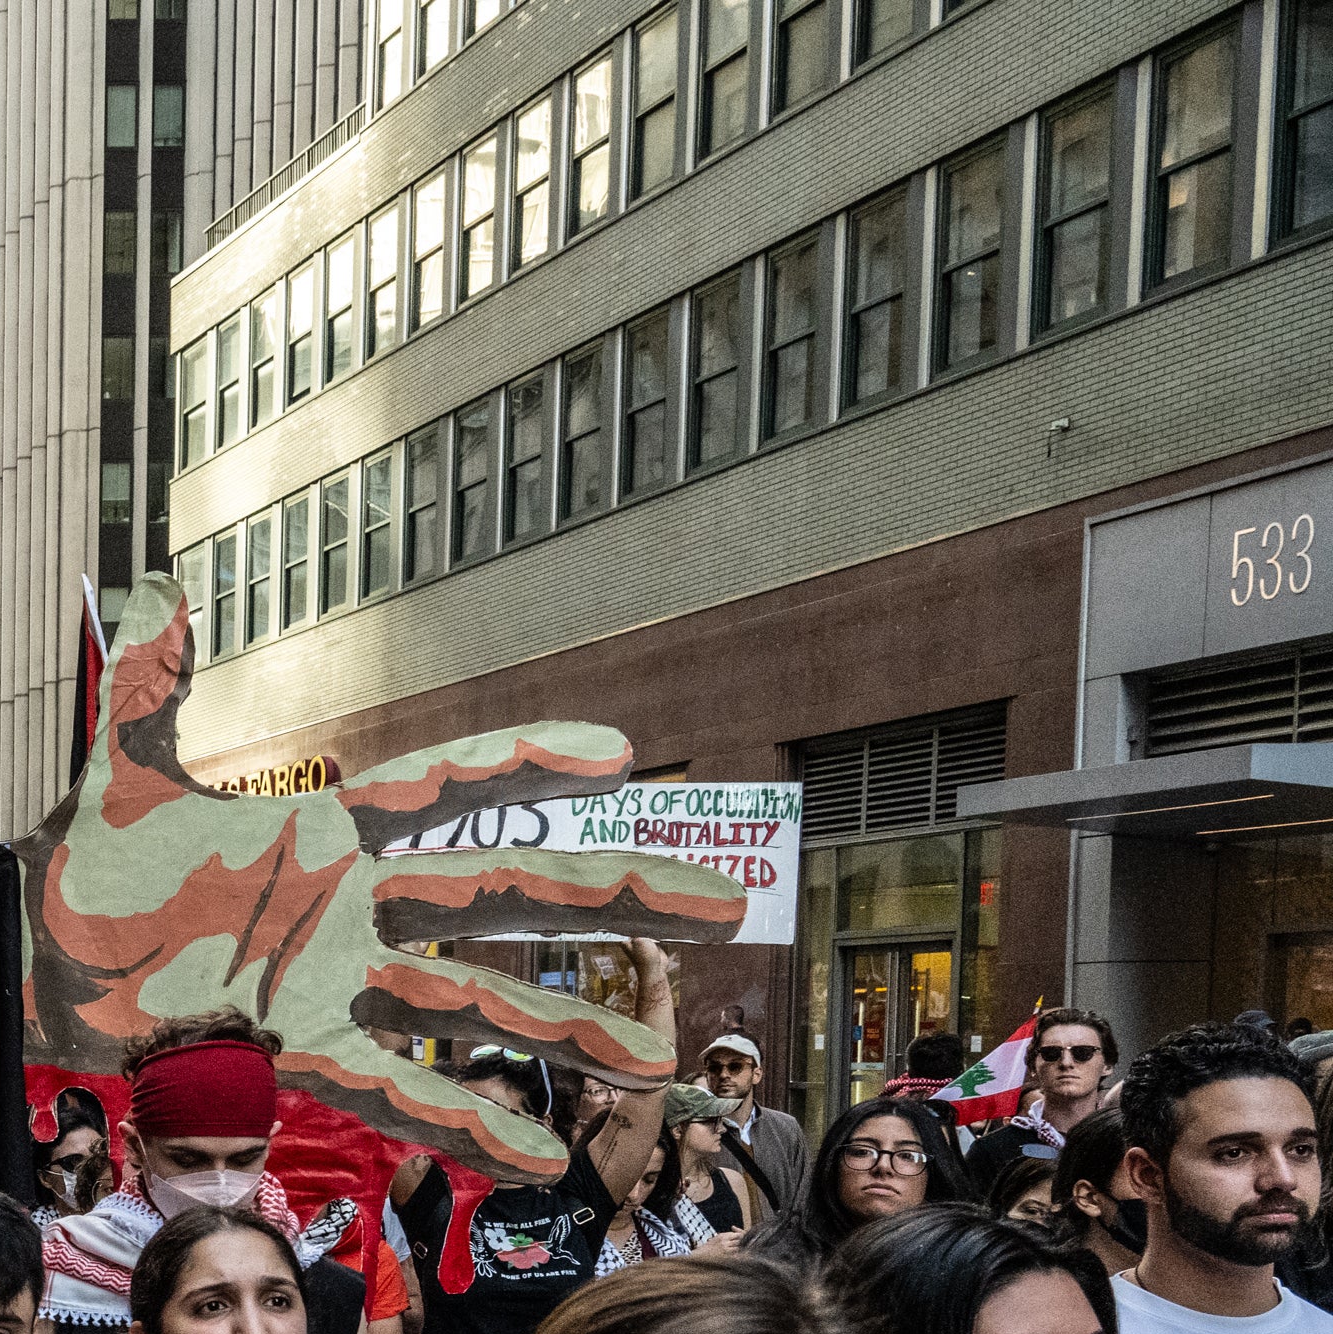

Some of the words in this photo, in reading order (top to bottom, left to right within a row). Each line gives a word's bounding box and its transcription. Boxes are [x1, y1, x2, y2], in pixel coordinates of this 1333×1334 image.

[1230, 513, 1315, 607] 533
[244, 754, 327, 798] FARGO
[571, 787, 644, 818] DAYS
[649, 789, 686, 816] OF
[685, 788, 802, 824] OCCUPATION
[579, 817, 631, 845] AND
[634, 817, 781, 848] BRUTALITY
[520, 1220, 534, 1229] ALL
[534, 1217, 552, 1227] FREE
